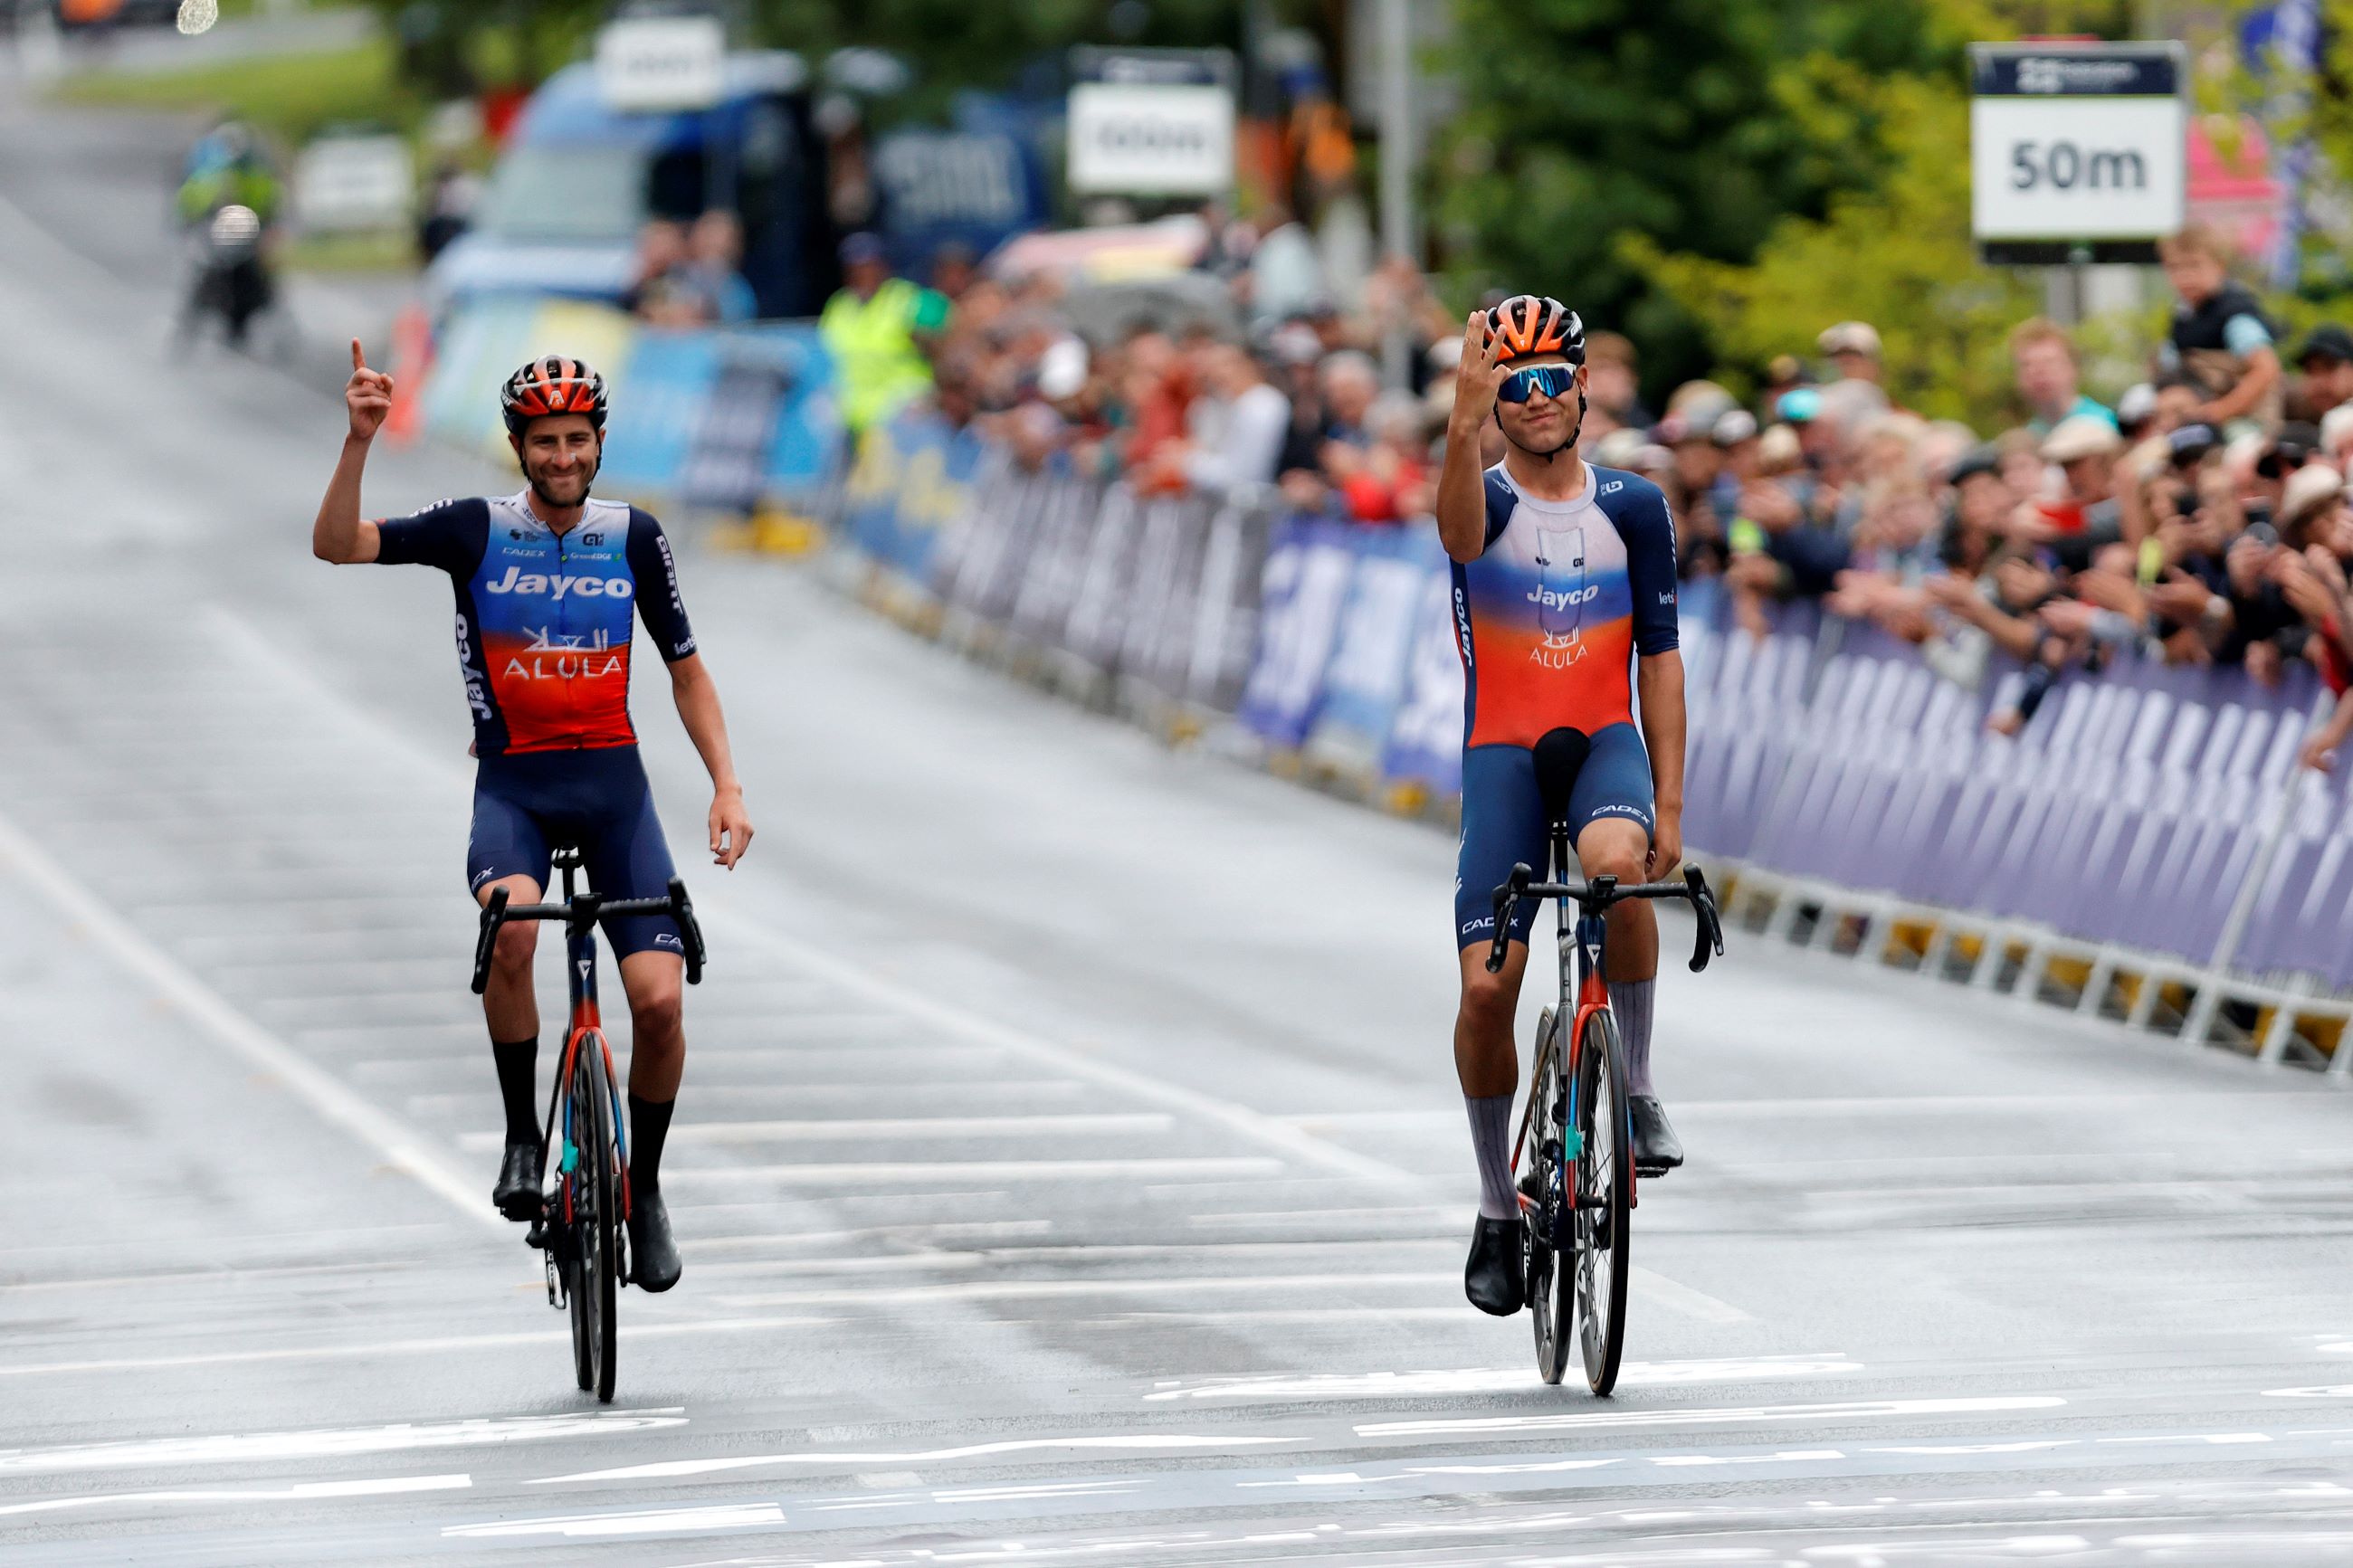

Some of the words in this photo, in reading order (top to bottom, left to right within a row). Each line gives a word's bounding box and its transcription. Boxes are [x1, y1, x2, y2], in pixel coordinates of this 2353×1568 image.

[2012, 141, 2146, 189] 50m
[502, 546, 546, 557] CADEX
[487, 566, 633, 600] Jayco
[655, 534, 685, 616] GIANT
[1527, 584, 1599, 612] Jayco
[1454, 587, 1473, 667] Jayco
[455, 613, 492, 722] Jayco
[503, 656, 623, 679] ALULA
[1529, 645, 1588, 670] ALULA
[1591, 804, 1651, 824] CADEX
[1462, 917, 1519, 935] CADX
